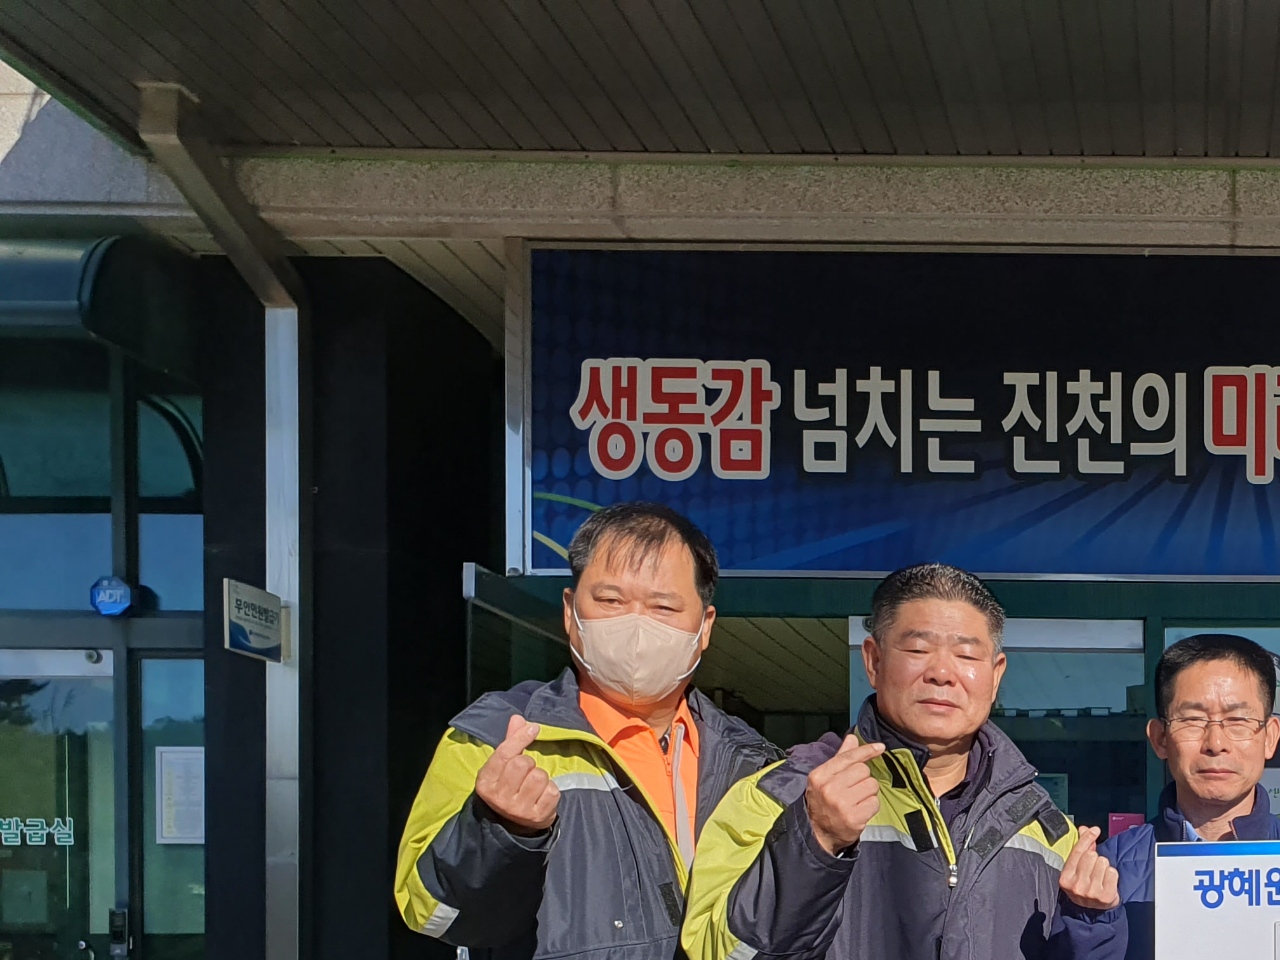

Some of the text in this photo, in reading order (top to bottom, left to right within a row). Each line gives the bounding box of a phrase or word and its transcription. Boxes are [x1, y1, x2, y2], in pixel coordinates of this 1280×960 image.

[571, 359, 779, 479] 생동감
[794, 366, 982, 474] 넘치는
[1001, 368, 1188, 476] 진천의
[96, 589, 125, 604] ADT
[234, 598, 280, 625] 무인민원발급기
[0, 817, 75, 846] 발급실
